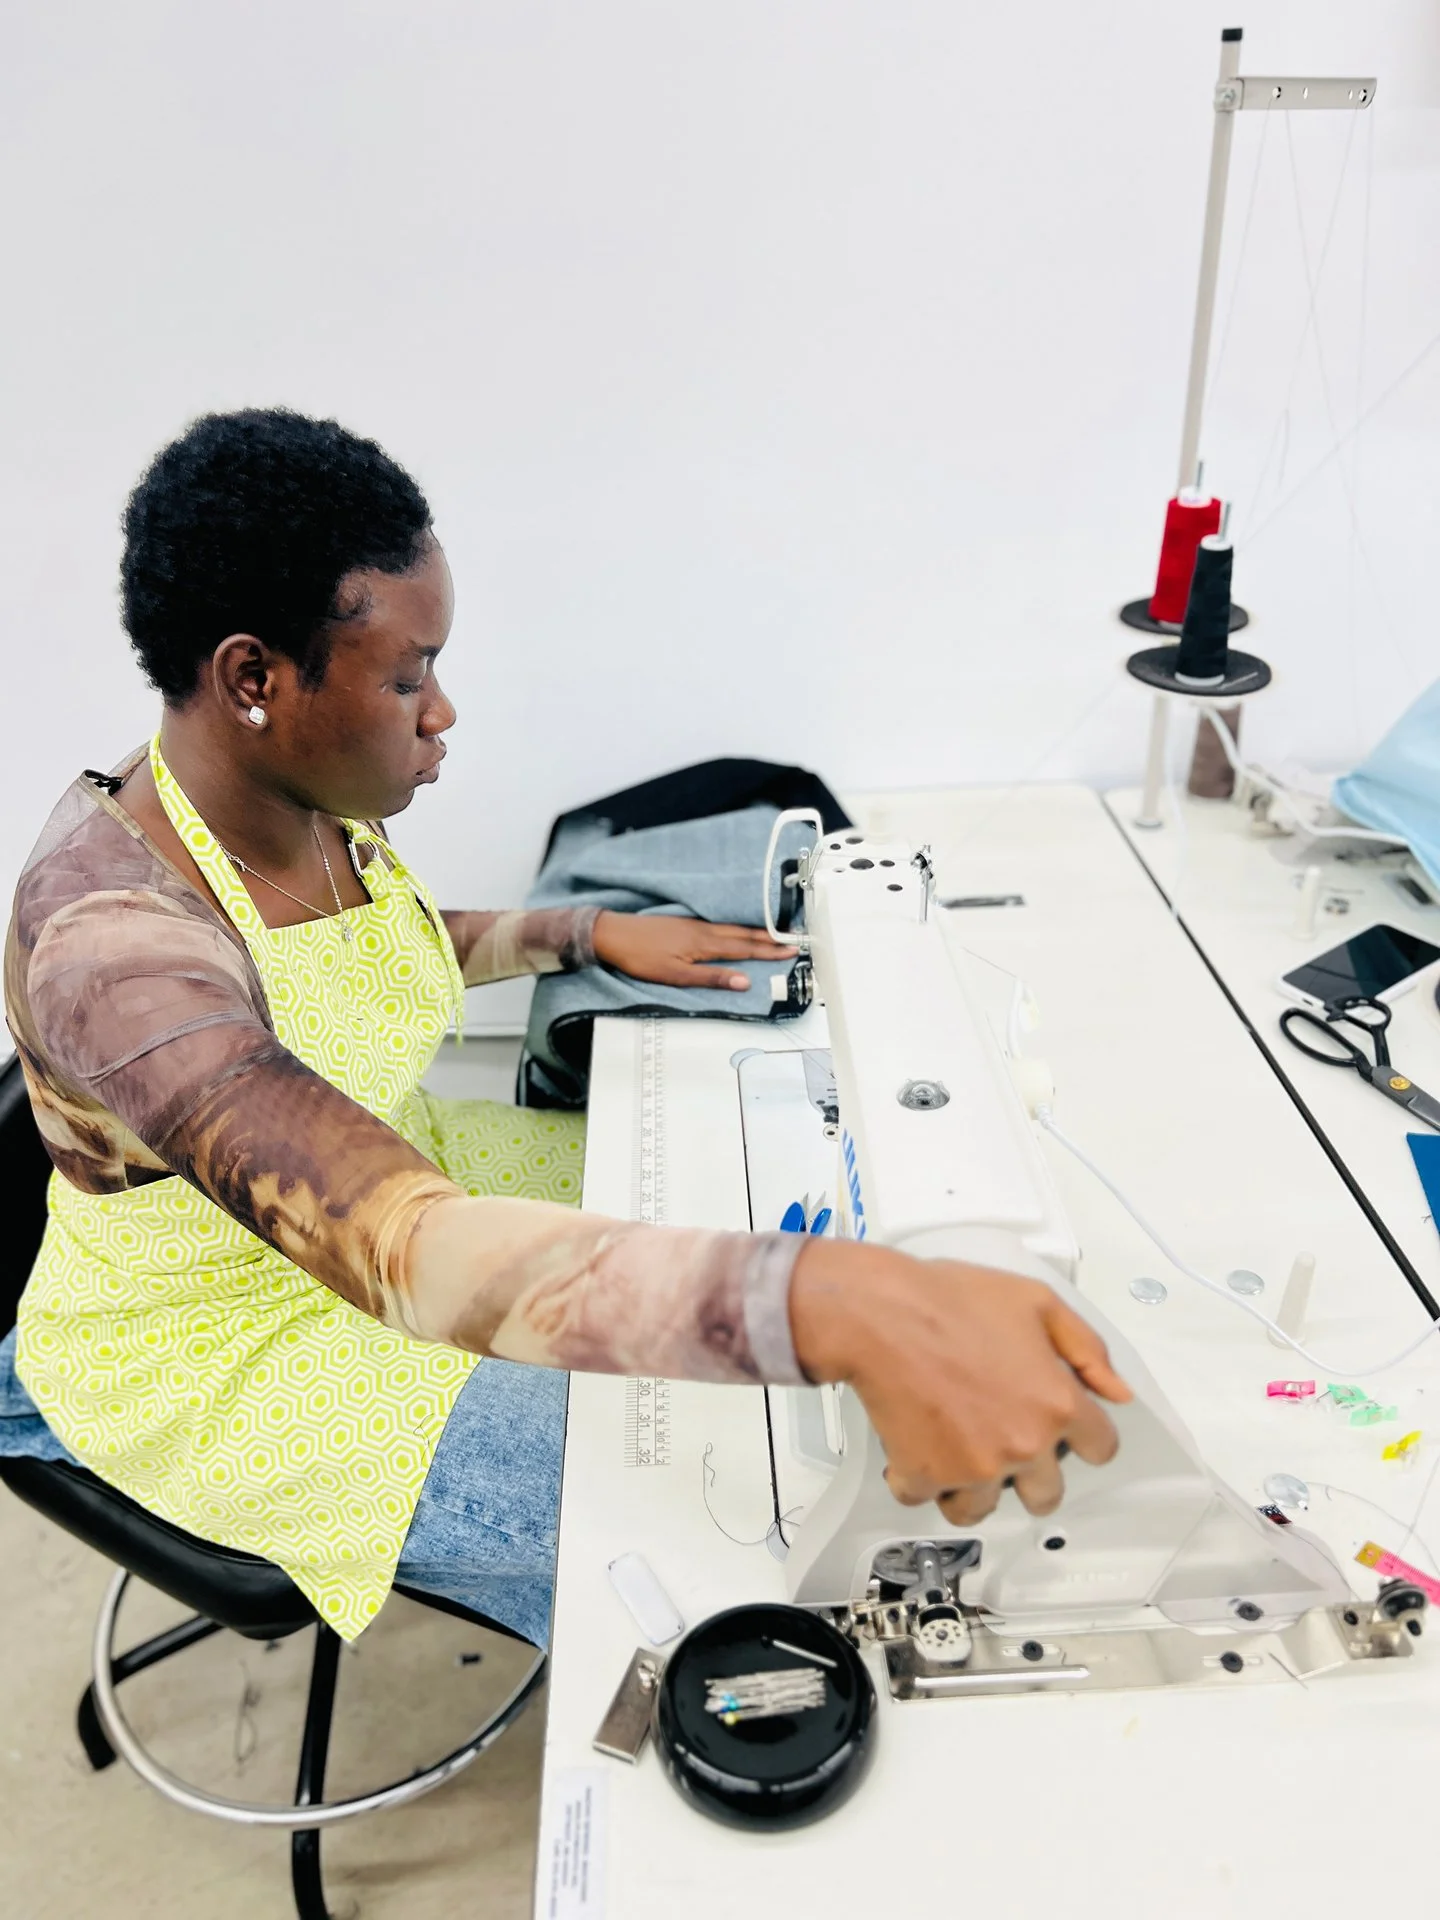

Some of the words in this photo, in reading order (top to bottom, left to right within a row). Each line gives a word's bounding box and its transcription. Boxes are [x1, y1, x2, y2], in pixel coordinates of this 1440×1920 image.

[639, 1382, 650, 1396] 30
[638, 1414, 650, 1428] 31
[638, 1449, 650, 1464] 32
